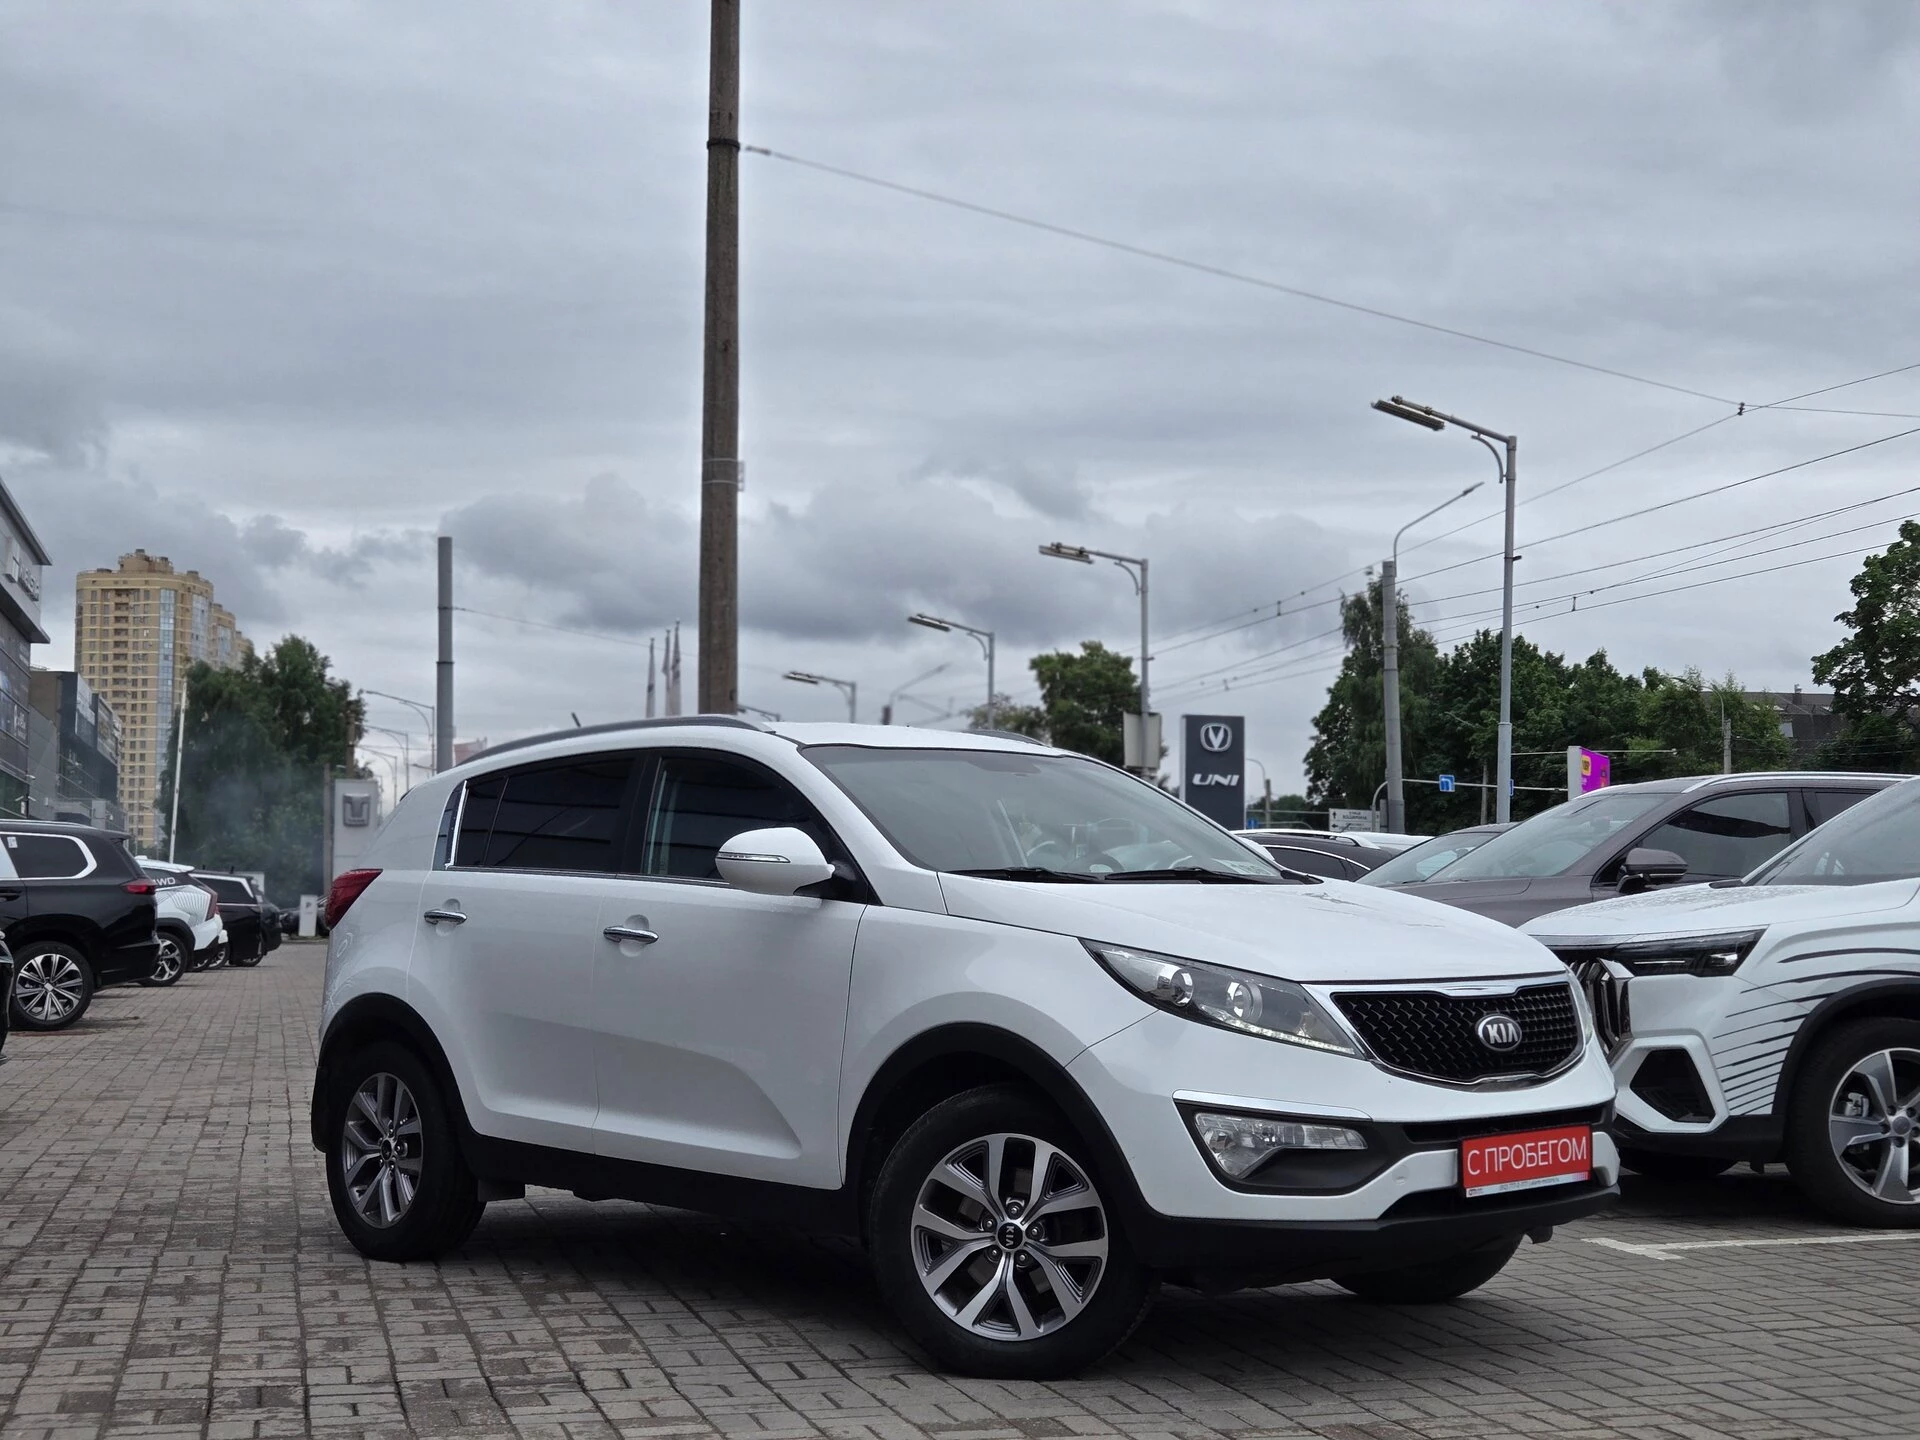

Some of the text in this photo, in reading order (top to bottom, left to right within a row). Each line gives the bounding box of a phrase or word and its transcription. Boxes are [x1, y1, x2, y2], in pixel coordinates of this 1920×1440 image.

[1192, 773, 1240, 786] UNI
[1485, 1022, 1518, 1044] KIA
[1467, 1136, 1587, 1175] С ПРОБЕГОМ
[1005, 1225, 1014, 1246] KIA
